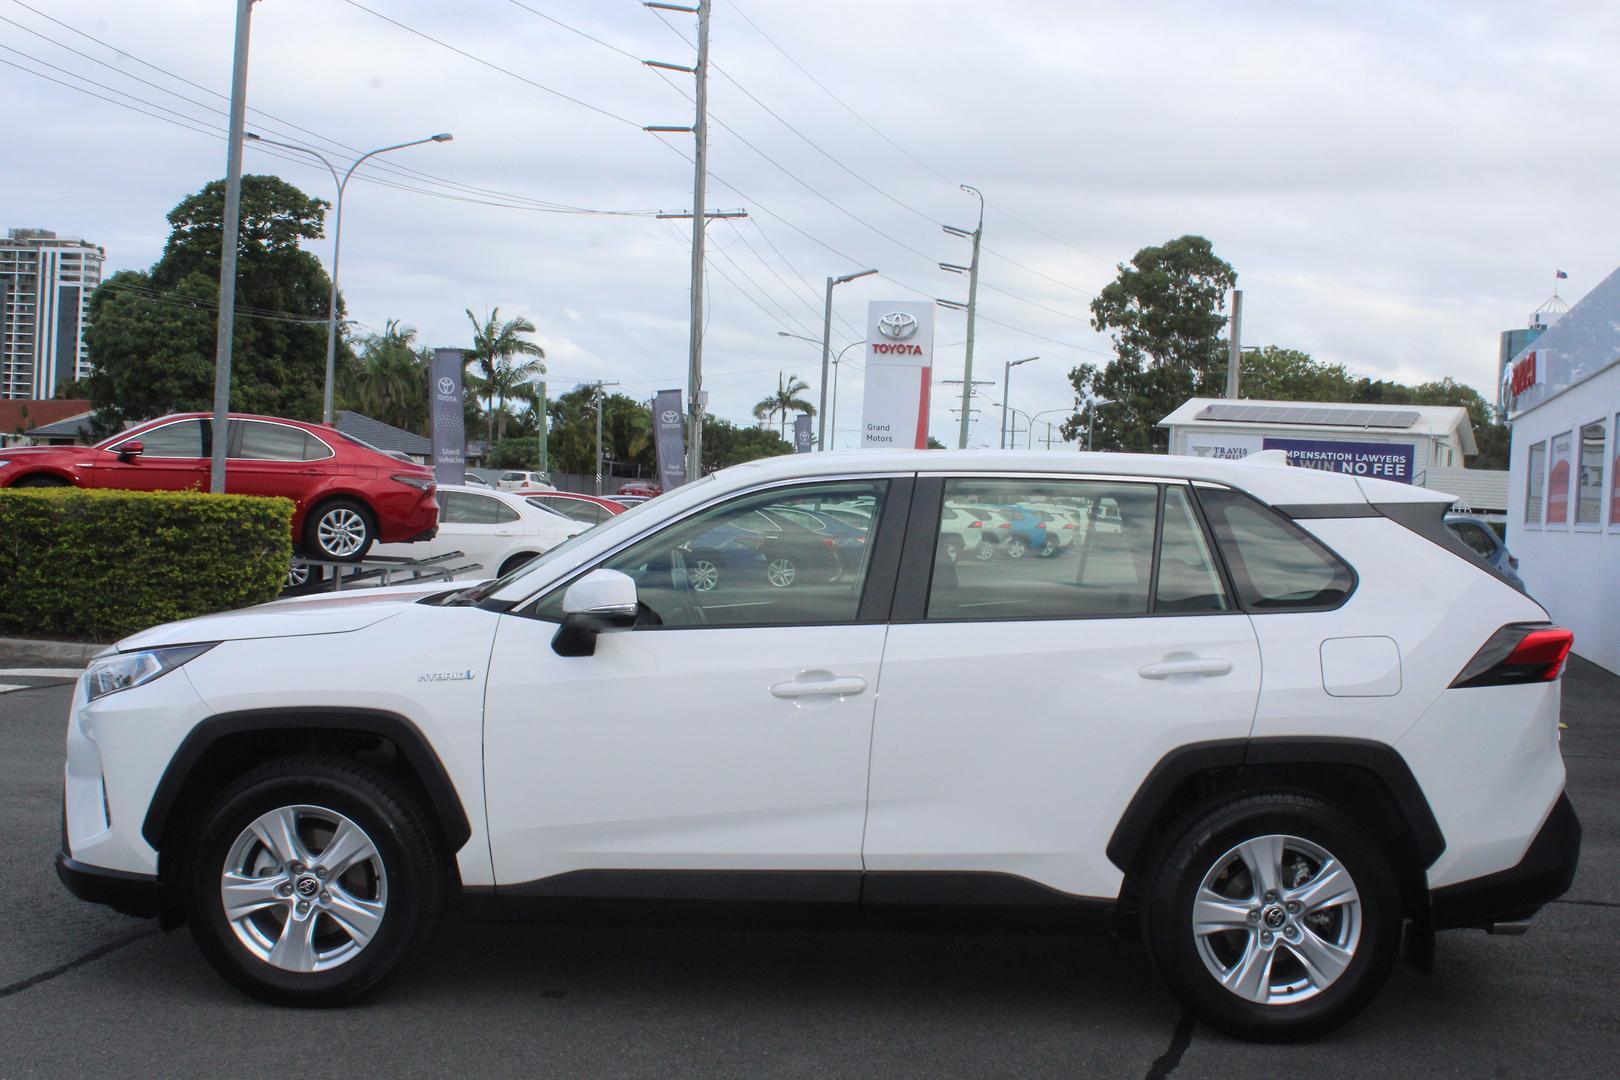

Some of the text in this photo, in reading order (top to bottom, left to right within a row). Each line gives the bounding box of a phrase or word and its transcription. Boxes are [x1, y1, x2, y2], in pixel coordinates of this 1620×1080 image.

[873, 343, 922, 355] TOYOTA
[437, 394, 457, 402] TOYOTA
[866, 434, 893, 442] Motors
[1214, 446, 1248, 454] TRAVIS
[438, 456, 465, 464] Vehicles
[1355, 453, 1406, 463] LAWYERS
[1342, 462, 1367, 474] NO
[1373, 463, 1405, 476] FEE
[418, 672, 464, 681] HYBRID
